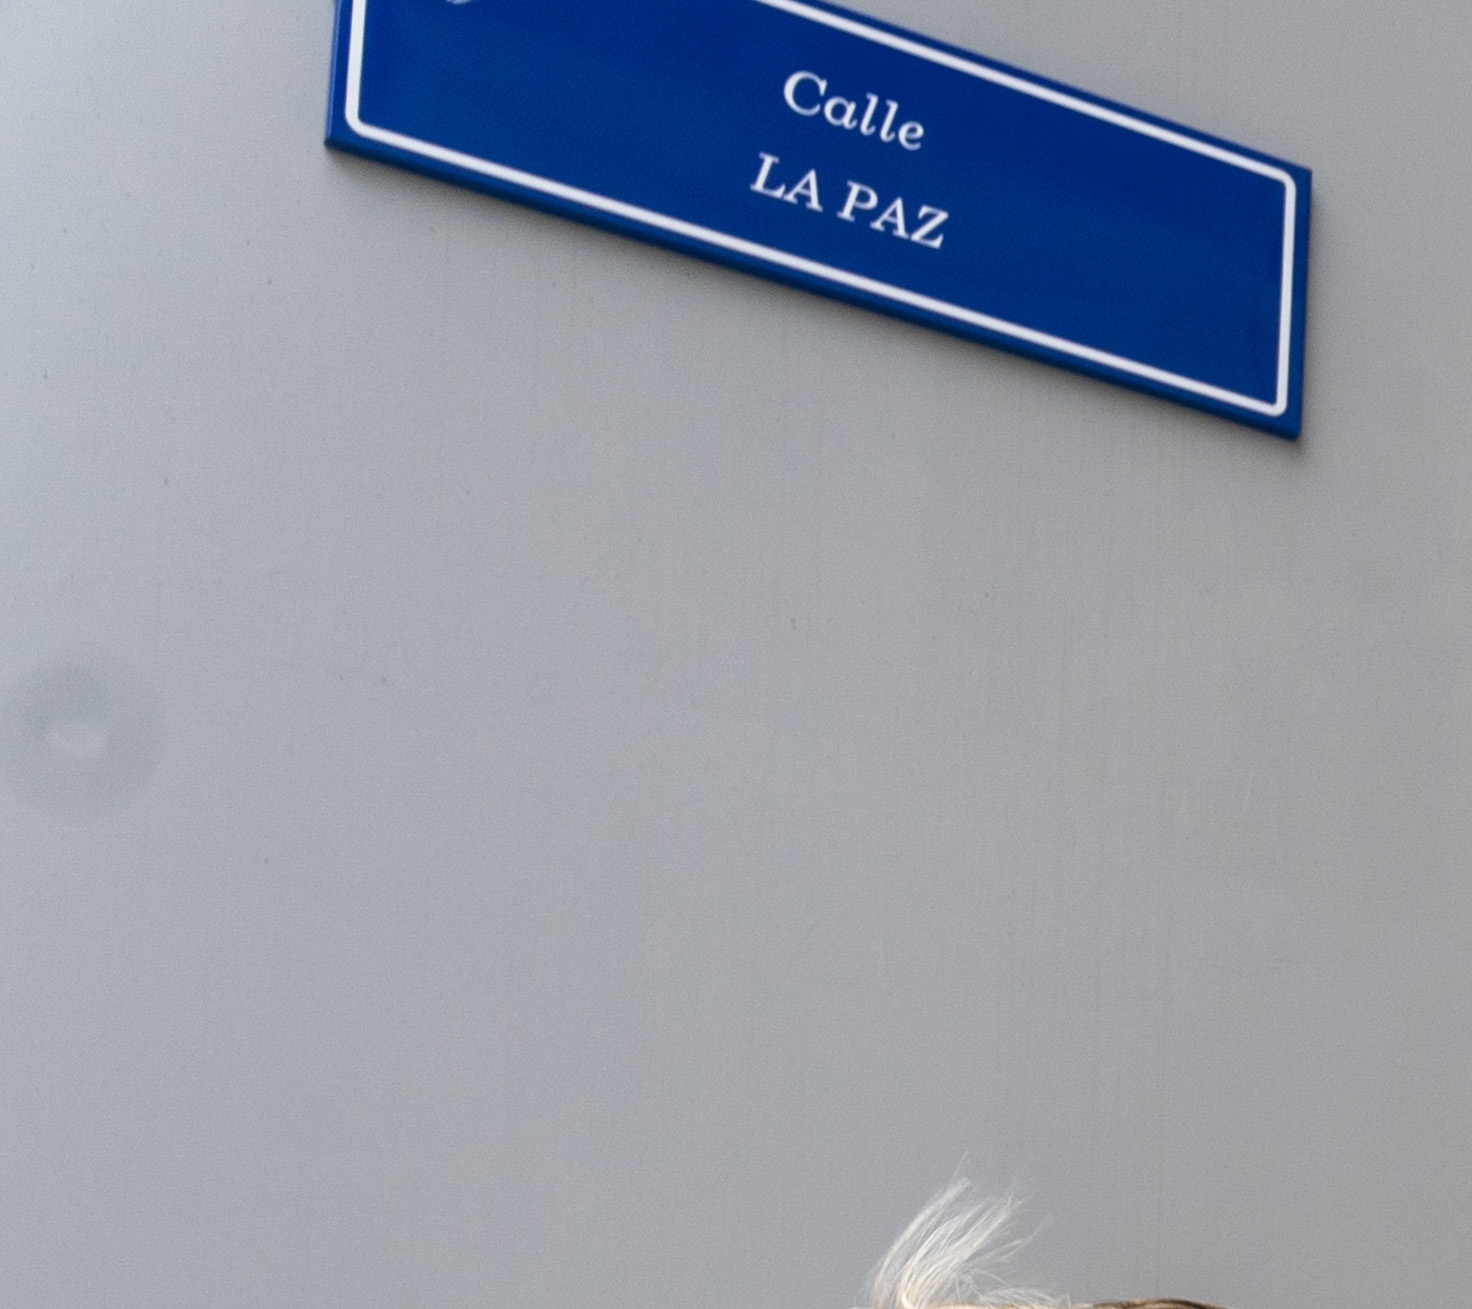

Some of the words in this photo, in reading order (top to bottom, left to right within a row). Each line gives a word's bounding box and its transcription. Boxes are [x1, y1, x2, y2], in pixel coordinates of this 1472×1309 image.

[782, 70, 925, 151] Calle
[750, 151, 824, 212] LA
[837, 180, 949, 250] PAZ
